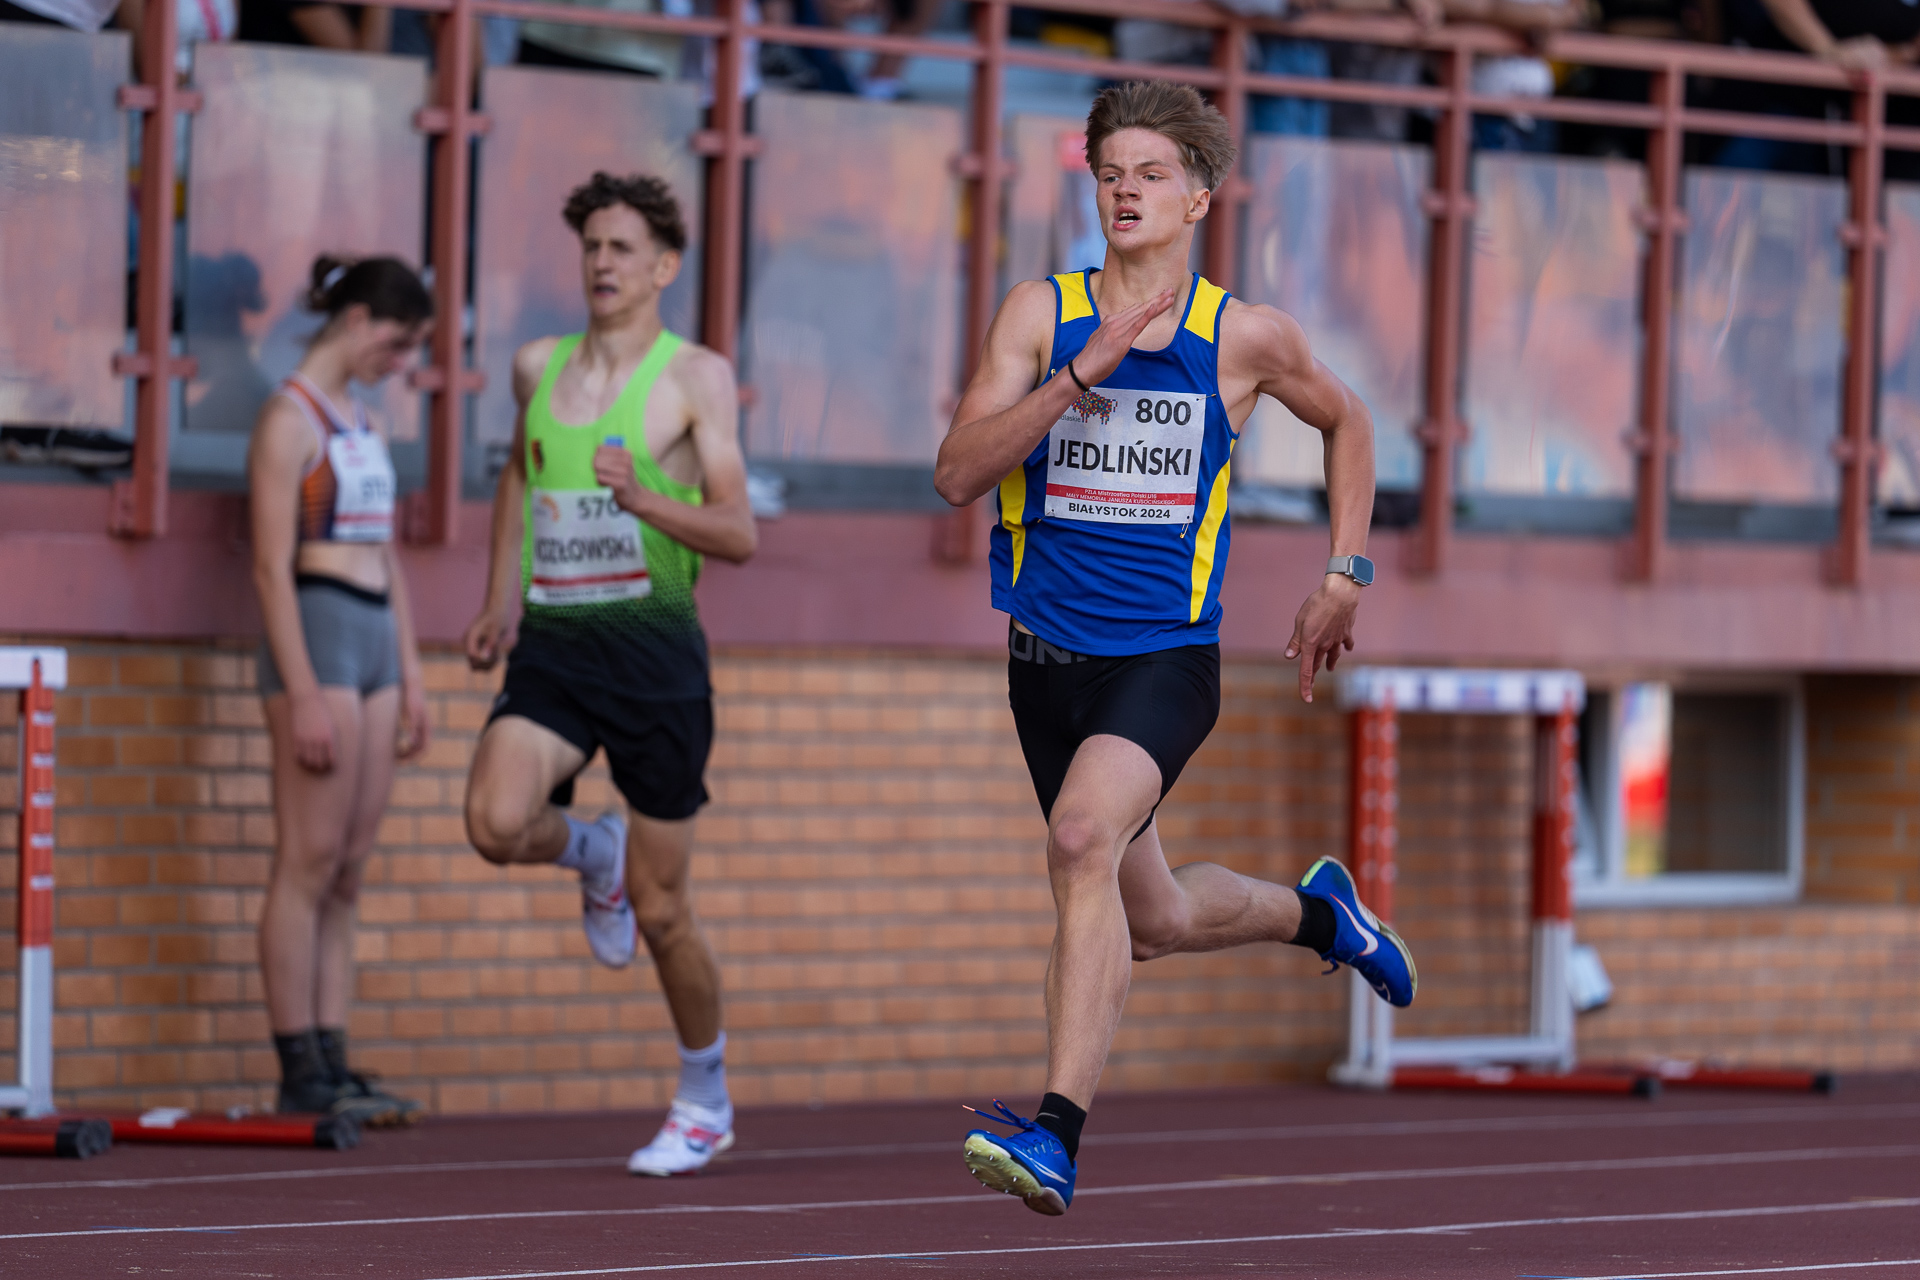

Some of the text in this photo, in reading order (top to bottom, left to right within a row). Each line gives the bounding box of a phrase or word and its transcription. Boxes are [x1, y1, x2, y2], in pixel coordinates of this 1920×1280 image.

[1135, 398, 1191, 425] 800
[1054, 439, 1192, 475] JEDLIŃSKI
[1097, 490, 1130, 498] Mistrzostwa
[1068, 502, 1171, 518] BIAŁYSTOK 2024
